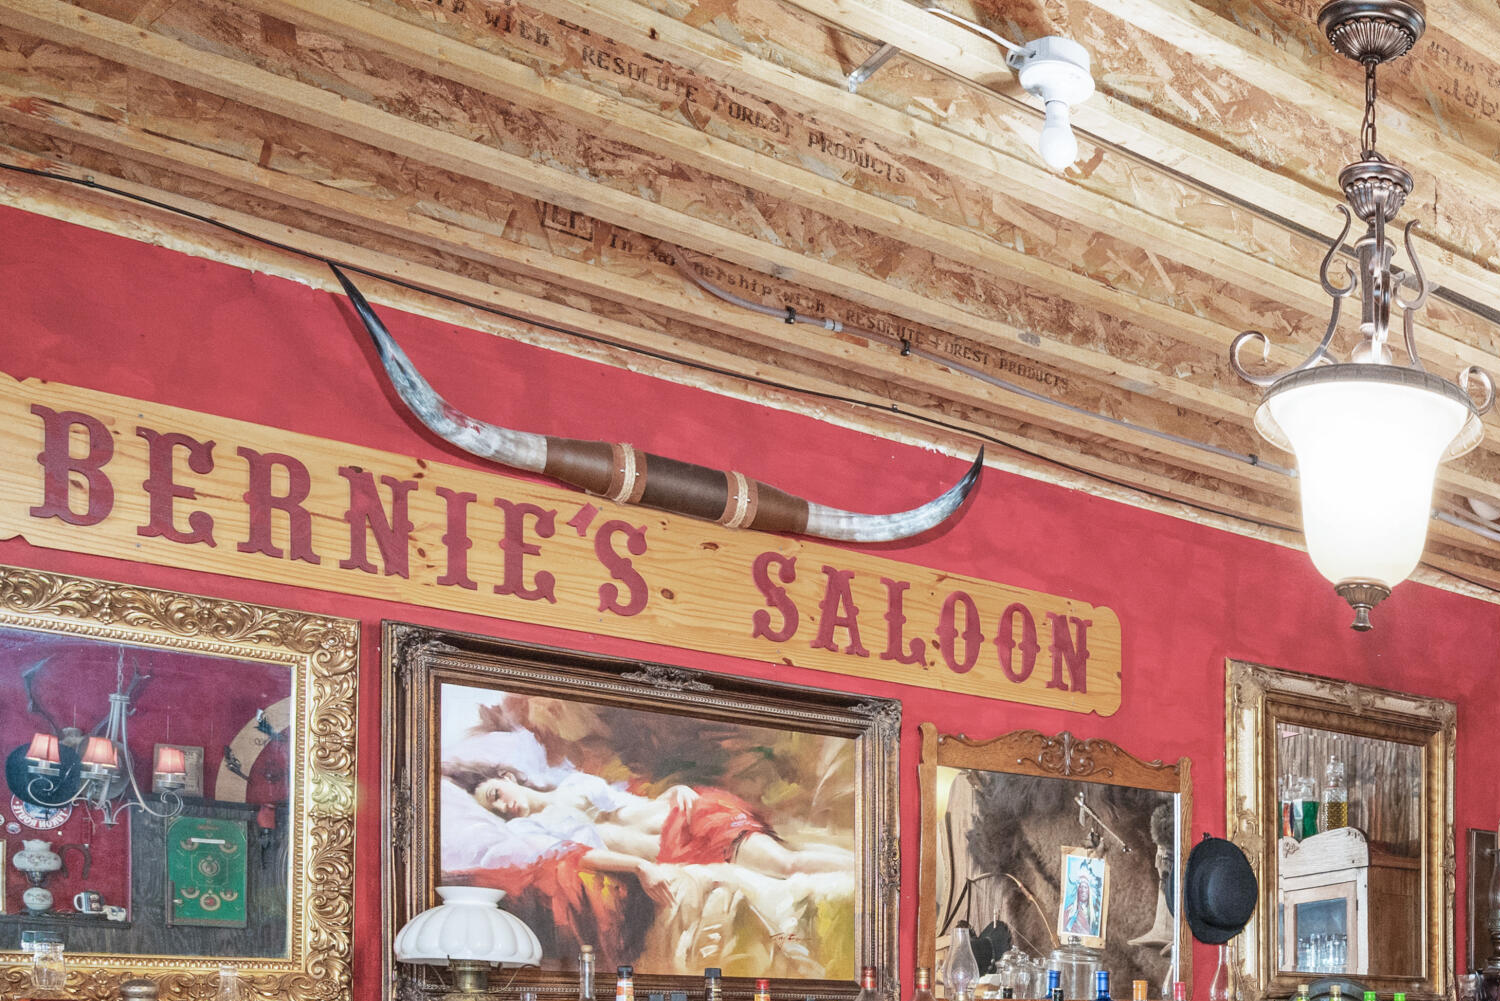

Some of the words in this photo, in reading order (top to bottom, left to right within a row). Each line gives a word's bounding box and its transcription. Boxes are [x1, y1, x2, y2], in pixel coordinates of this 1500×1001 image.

[581, 45, 699, 104] RESOLUTE
[711, 89, 794, 139] FOREST
[807, 130, 907, 184] PRODUCTS
[609, 232, 634, 253] In
[846, 310, 925, 342] RESOLUTE
[929, 334, 990, 366] FOREST
[999, 358, 1070, 391] PRODUCTS
[29, 403, 649, 617] BERNIE'S
[751, 551, 1093, 695] SALOON
